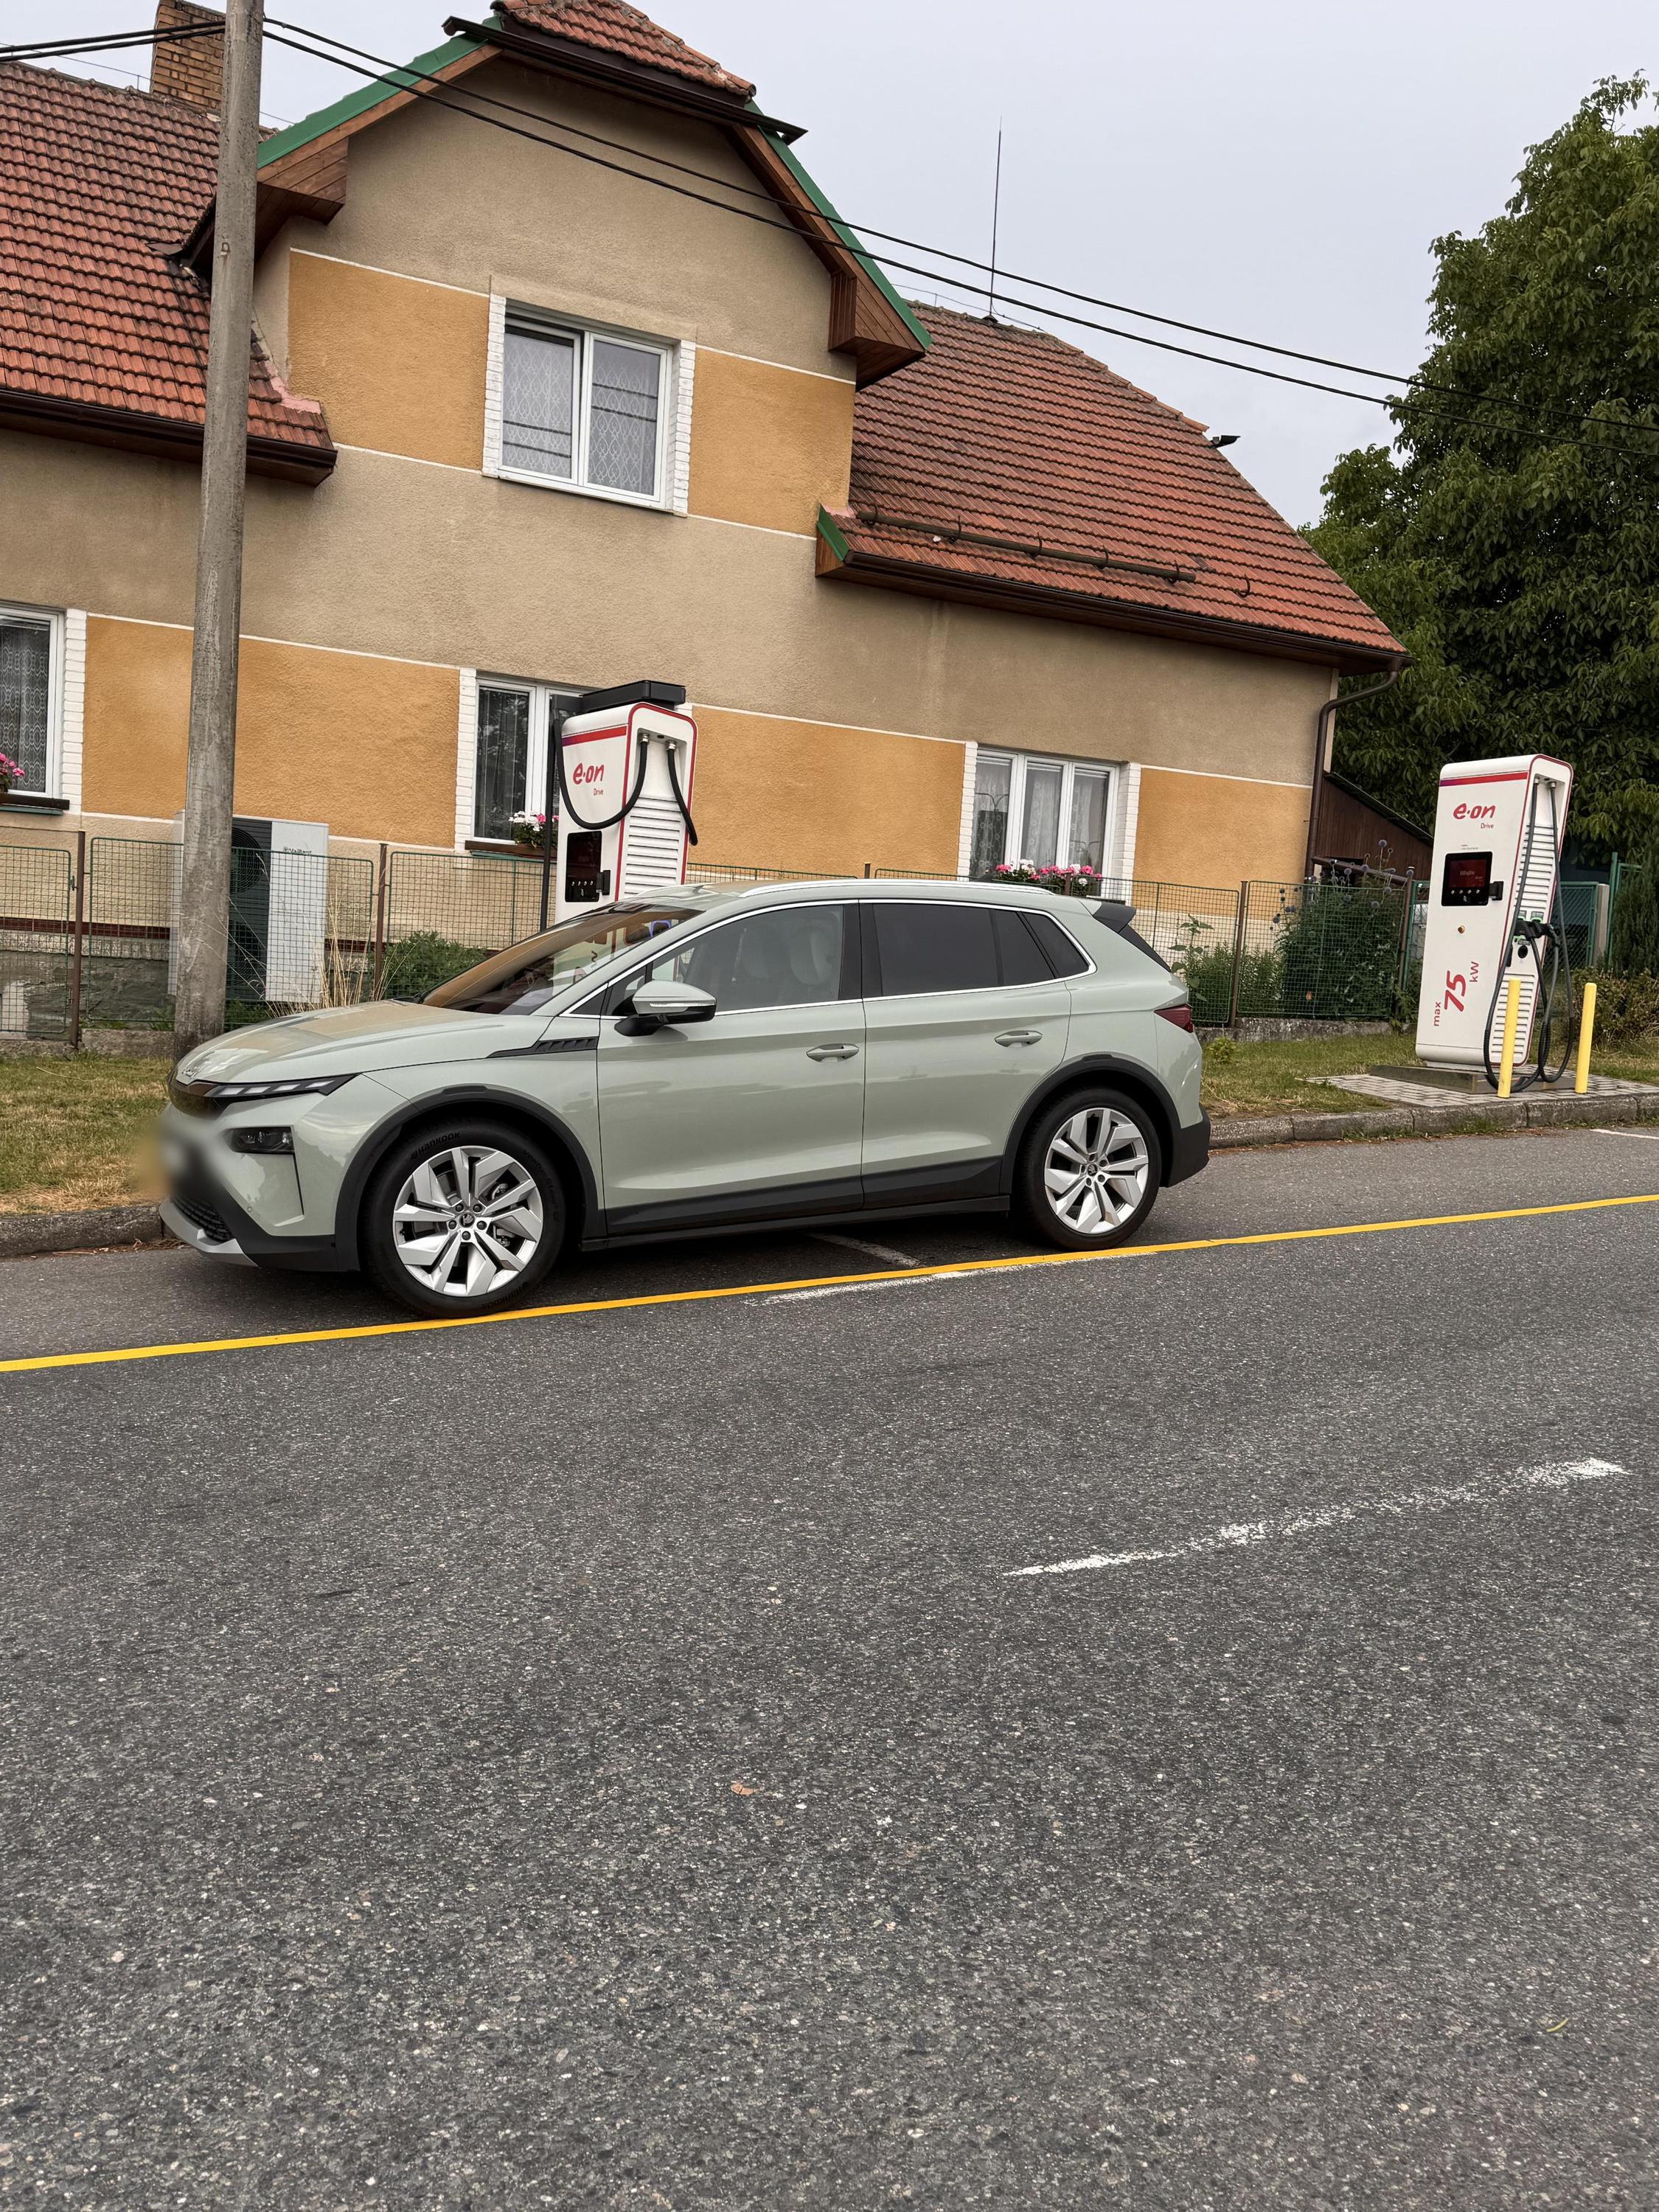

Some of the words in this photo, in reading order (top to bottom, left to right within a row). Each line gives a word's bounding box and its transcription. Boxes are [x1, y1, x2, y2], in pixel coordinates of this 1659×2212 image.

[1469, 961, 1479, 983] kW
[1444, 970, 1467, 1012] 75
[1433, 1001, 1441, 1027] max
